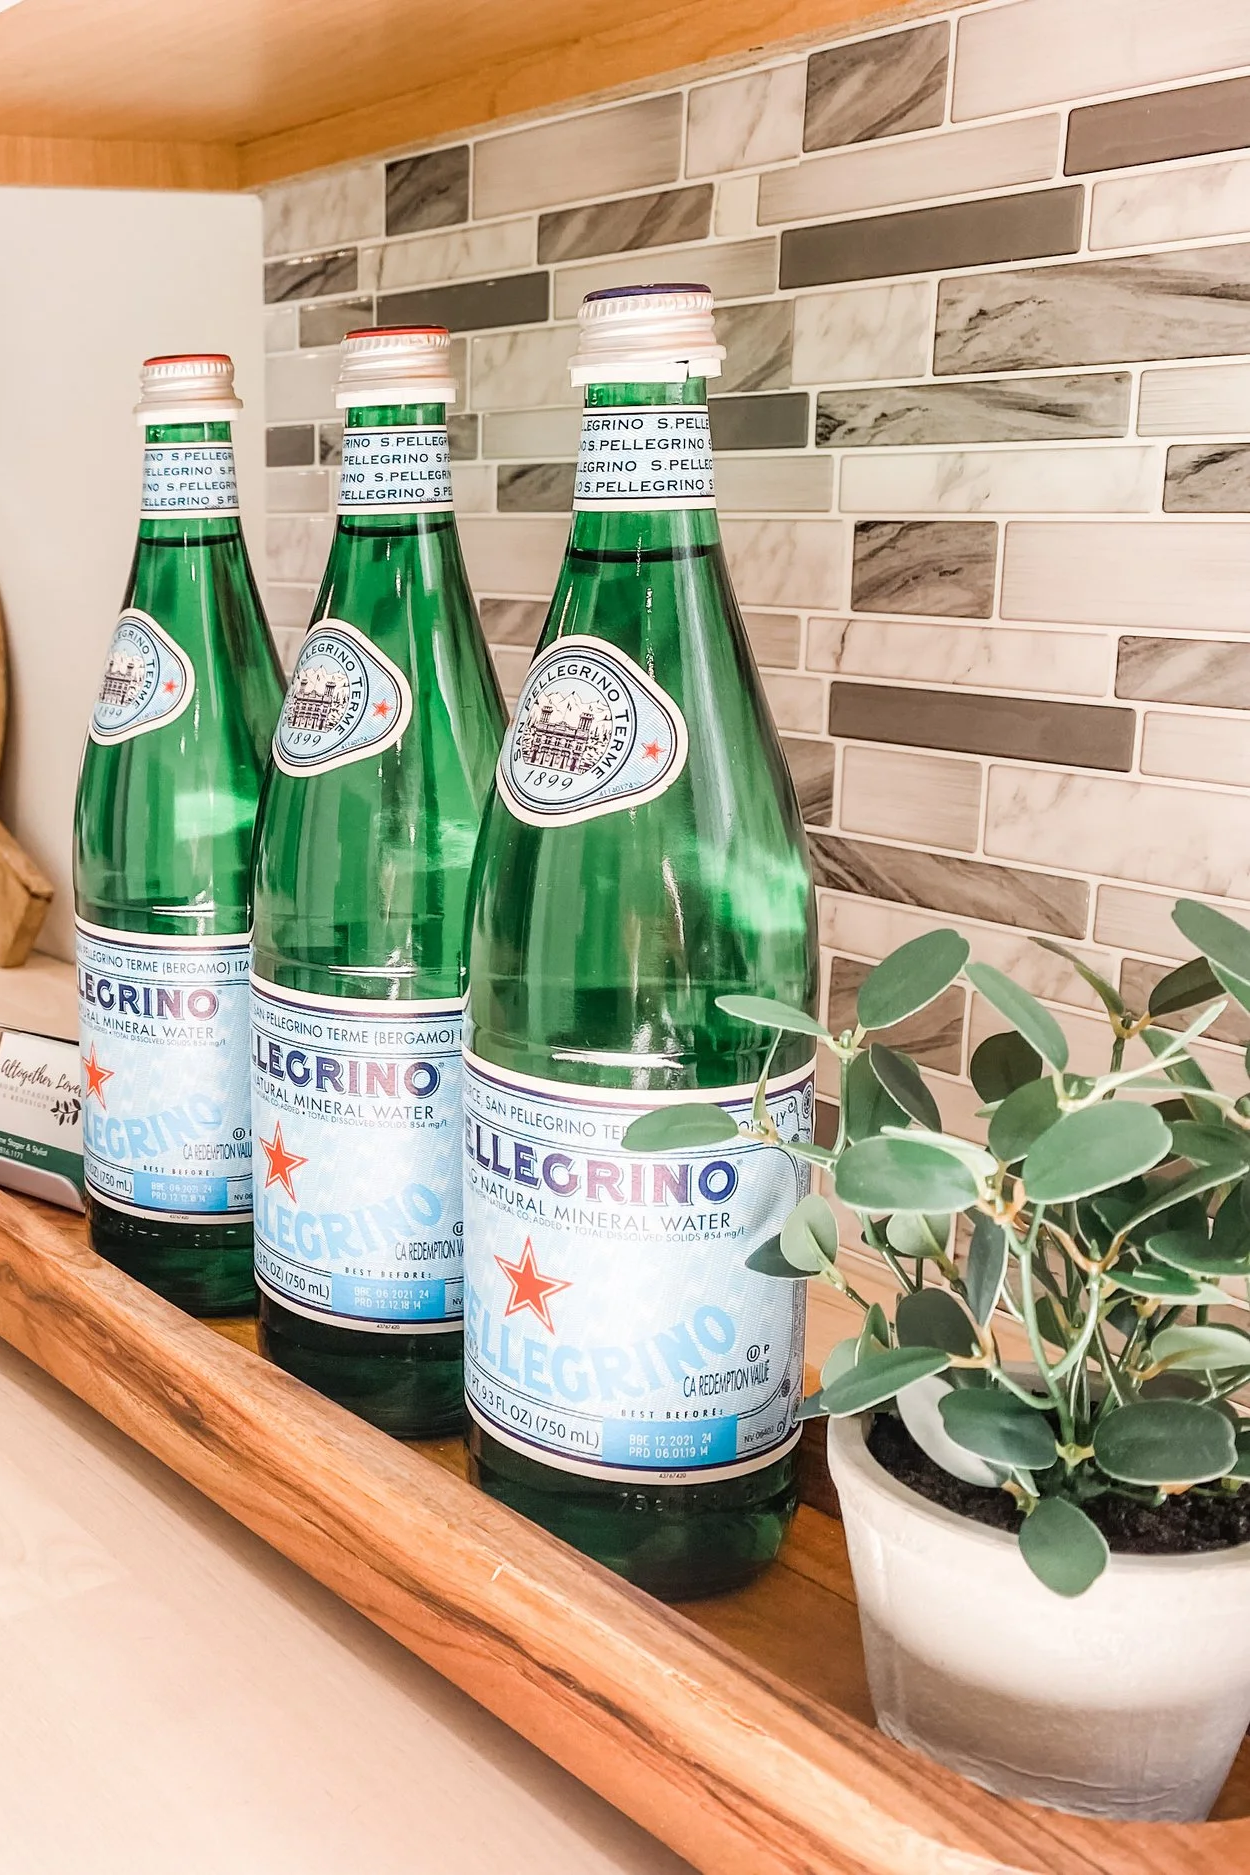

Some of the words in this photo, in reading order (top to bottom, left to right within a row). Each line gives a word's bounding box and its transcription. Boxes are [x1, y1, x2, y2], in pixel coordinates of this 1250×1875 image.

[588, 438, 704, 451] S.PELLEGRINO
[584, 479, 705, 493] S.PELLEGRINO
[132, 658, 155, 710] TERME
[334, 676, 363, 736] TERME
[513, 721, 525, 762] SAN
[524, 664, 620, 712] PELLEGRINO
[591, 709, 629, 780] TERME
[287, 731, 322, 747] 1899
[523, 769, 574, 792] 1899
[126, 958, 158, 973] TERME
[162, 961, 230, 975] (BERGAMO)
[103, 1016, 157, 1037] MINERAL
[162, 1025, 214, 1039] WATER
[266, 1010, 323, 1038] PELLEGRINO
[327, 1026, 369, 1044] TERME
[374, 1029, 455, 1046] (BERGAMO)
[1, 1059, 54, 1087] Altogether
[294, 1092, 363, 1118] MINERAL
[372, 1106, 434, 1120] WATER
[307, 1111, 329, 1122] TOTAL
[331, 1115, 375, 1128] DISSOLVED
[485, 1095, 507, 1117] SAN
[511, 1106, 596, 1138] PELLEGRINO
[183, 1143, 193, 1160] CA
[195, 1143, 236, 1160] REDEMPTION
[143, 1164, 164, 1174] BEST
[151, 1191, 166, 1201] PRD
[481, 1176, 546, 1216] NATURAL
[554, 1205, 651, 1231] MINERAL
[659, 1212, 730, 1231] WATER
[533, 1216, 562, 1230] ADDED
[574, 1225, 603, 1237] TOTAL
[607, 1230, 662, 1242] DISSOLVED
[666, 1233, 701, 1242] SOLIDS
[704, 1231, 721, 1240] 854
[395, 1242, 407, 1260] CA
[409, 1240, 456, 1260] REDEMPTION
[271, 1262, 283, 1282] OZ)
[285, 1271, 305, 1291] (750
[308, 1283, 330, 1300] mL)
[345, 1266, 371, 1277] BEST
[354, 1297, 372, 1308] PRD
[419, 1289, 429, 1298] 24
[684, 1375, 696, 1397] CA
[699, 1369, 748, 1396] REDEMPTION
[750, 1359, 770, 1386] VALUE
[496, 1396, 508, 1416] FL
[510, 1406, 532, 1429] OZ)
[535, 1416, 566, 1439] (750
[570, 1430, 599, 1449] mL)
[621, 1410, 654, 1419] BEST
[629, 1435, 649, 1446] BBE
[701, 1433, 712, 1443] 24
[629, 1446, 651, 1457] PRD
